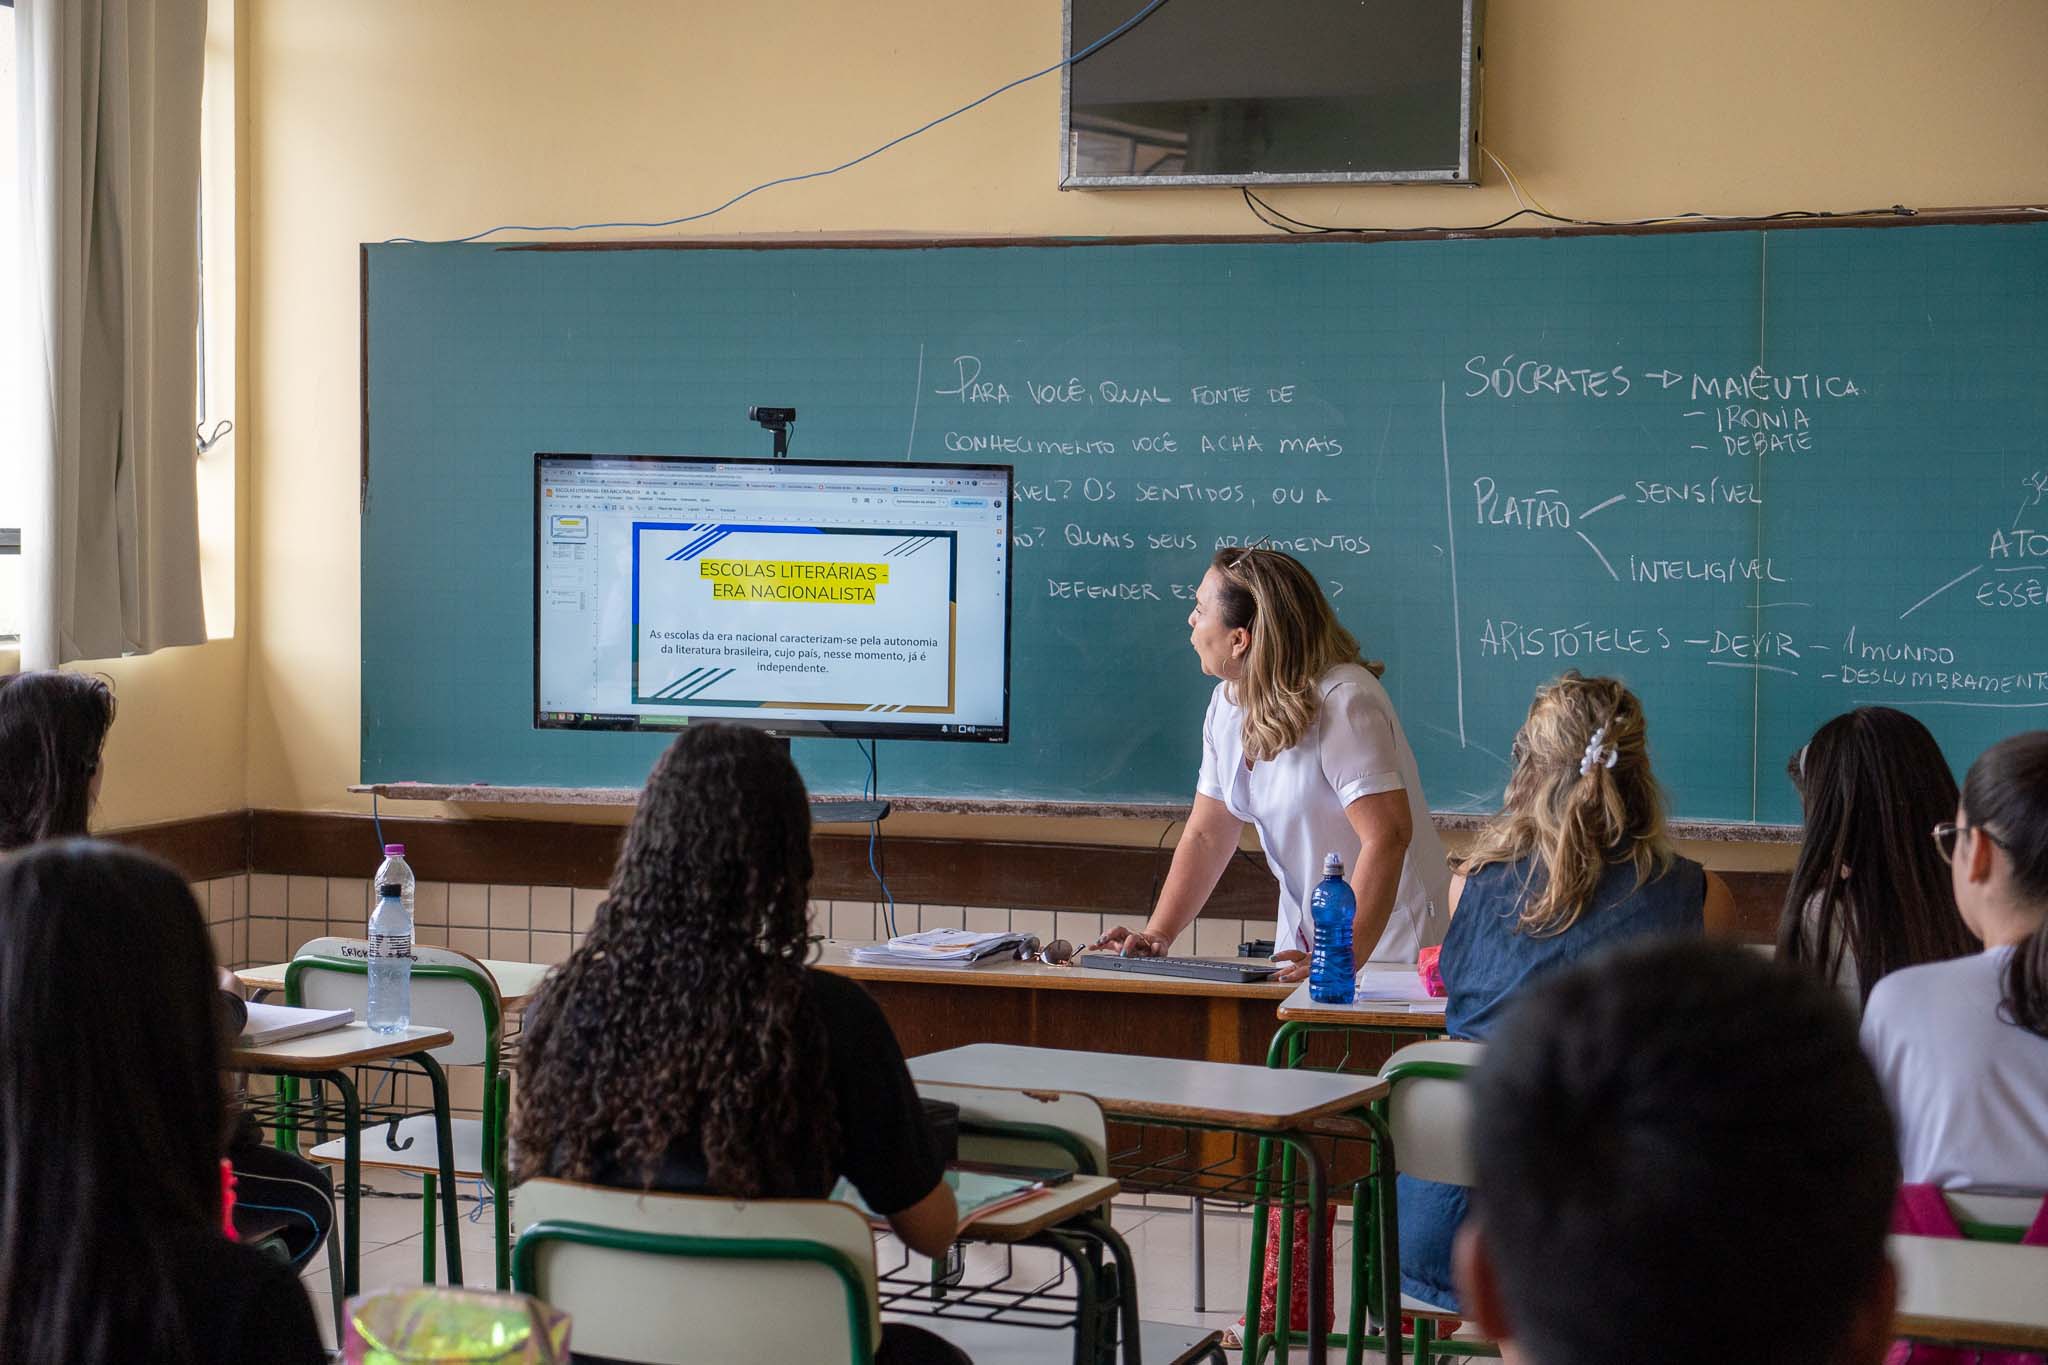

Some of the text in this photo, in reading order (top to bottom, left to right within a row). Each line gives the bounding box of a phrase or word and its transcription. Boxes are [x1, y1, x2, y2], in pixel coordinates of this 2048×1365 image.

[1465, 354, 1631, 399] SÓCRATES
[1100, 380, 1171, 404] QUAL
[1192, 385, 1250, 406] FONTE
[1269, 385, 1297, 404] DE
[1717, 405, 1811, 432] IRONIA
[1131, 430, 1177, 454] VOCÊ
[1201, 433, 1264, 454] ACHA
[1280, 430, 1343, 456] MAIS
[1723, 431, 1813, 456] DEBATE
[1083, 477, 1116, 501] OS
[1272, 484, 1304, 504] OU
[1316, 486, 1331, 503] A
[1473, 476, 1570, 528] PLATÃO
[1634, 475, 1762, 503] SENSÍVEL
[1064, 523, 1135, 549] QUAIS
[1148, 533, 1197, 550] SEUS
[700, 562, 776, 578] ESCOLAS
[781, 562, 878, 581] LITERÁRIAS
[713, 583, 876, 601] ERA NACIONALISTA
[1048, 578, 1161, 600] DEFENDER
[1171, 583, 1197, 600] ES
[1976, 579, 2048, 607] ESSÊ
[649, 629, 938, 648] As escolas da era nacional caracterizam-se pela autonomia
[1480, 619, 1671, 661] ARISTÓTELES
[1862, 641, 1954, 664] MUNDO
[660, 644, 927, 663] da literatura brasileira, cujo país, nesse momento, já é
[757, 661, 829, 674] independente.
